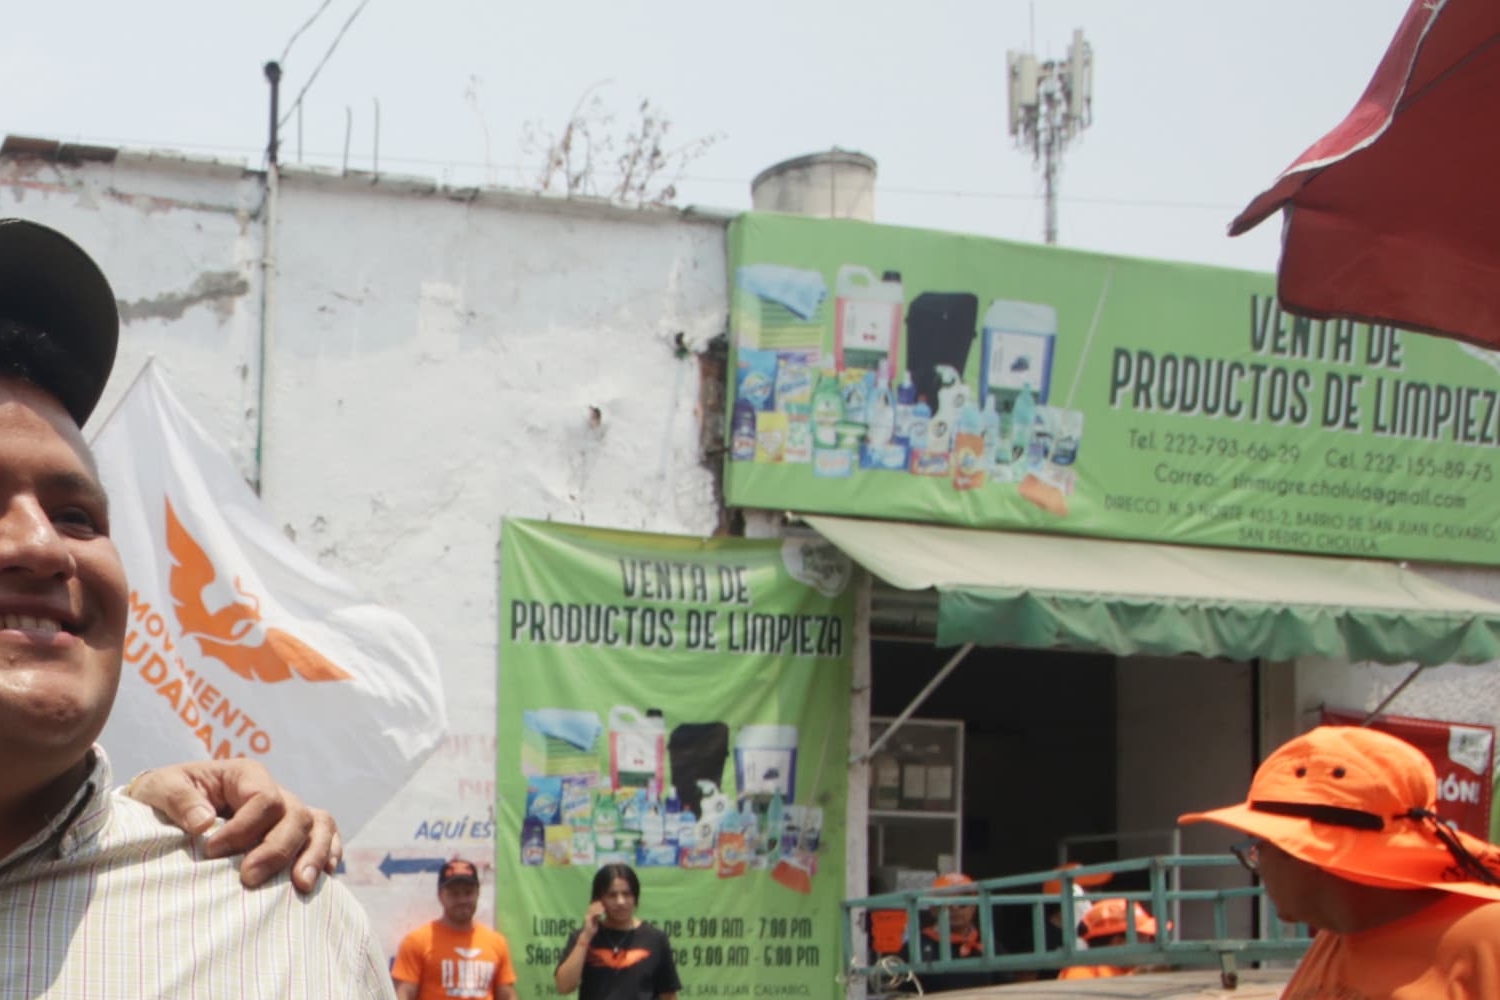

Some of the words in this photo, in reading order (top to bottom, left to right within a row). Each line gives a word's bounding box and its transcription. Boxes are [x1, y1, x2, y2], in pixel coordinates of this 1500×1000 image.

[1109, 346, 1313, 426] PRODUCTOS
[1322, 370, 1364, 433] DE
[1372, 376, 1500, 447] LIMPIEZ
[620, 557, 709, 603] VENTA
[719, 563, 751, 604] DE
[510, 599, 675, 648] PRODUCTOS
[686, 608, 719, 651] DE
[727, 610, 843, 657] LIMPIEZA
